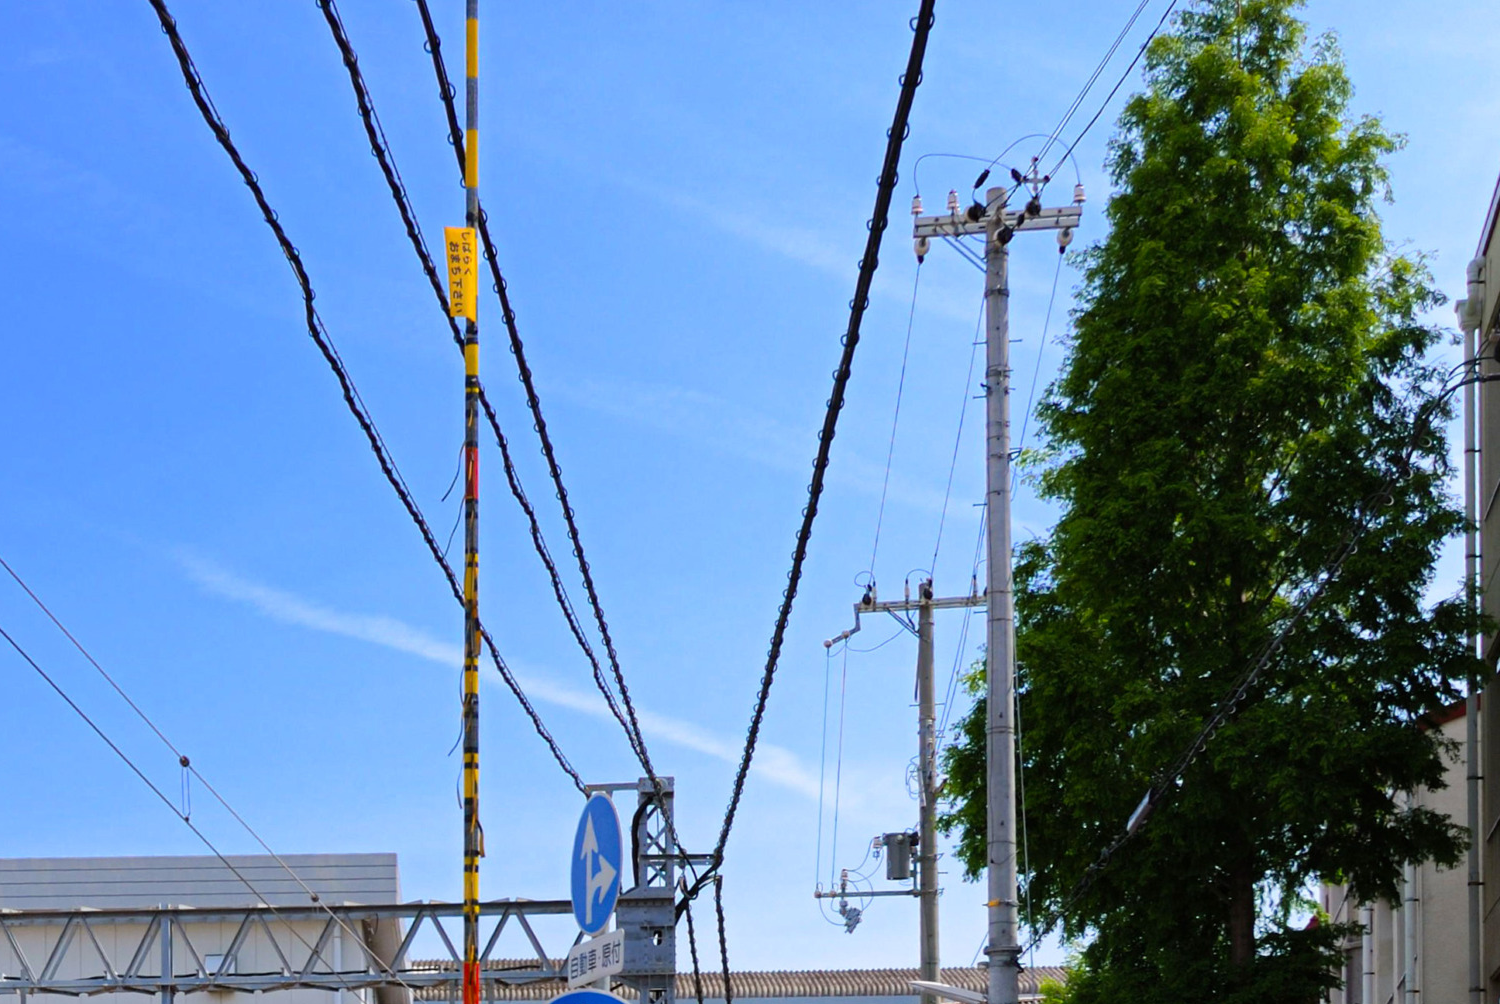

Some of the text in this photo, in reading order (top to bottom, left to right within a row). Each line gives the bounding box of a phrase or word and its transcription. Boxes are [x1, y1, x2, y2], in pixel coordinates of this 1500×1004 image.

[449, 241, 463, 314] おまち下さい
